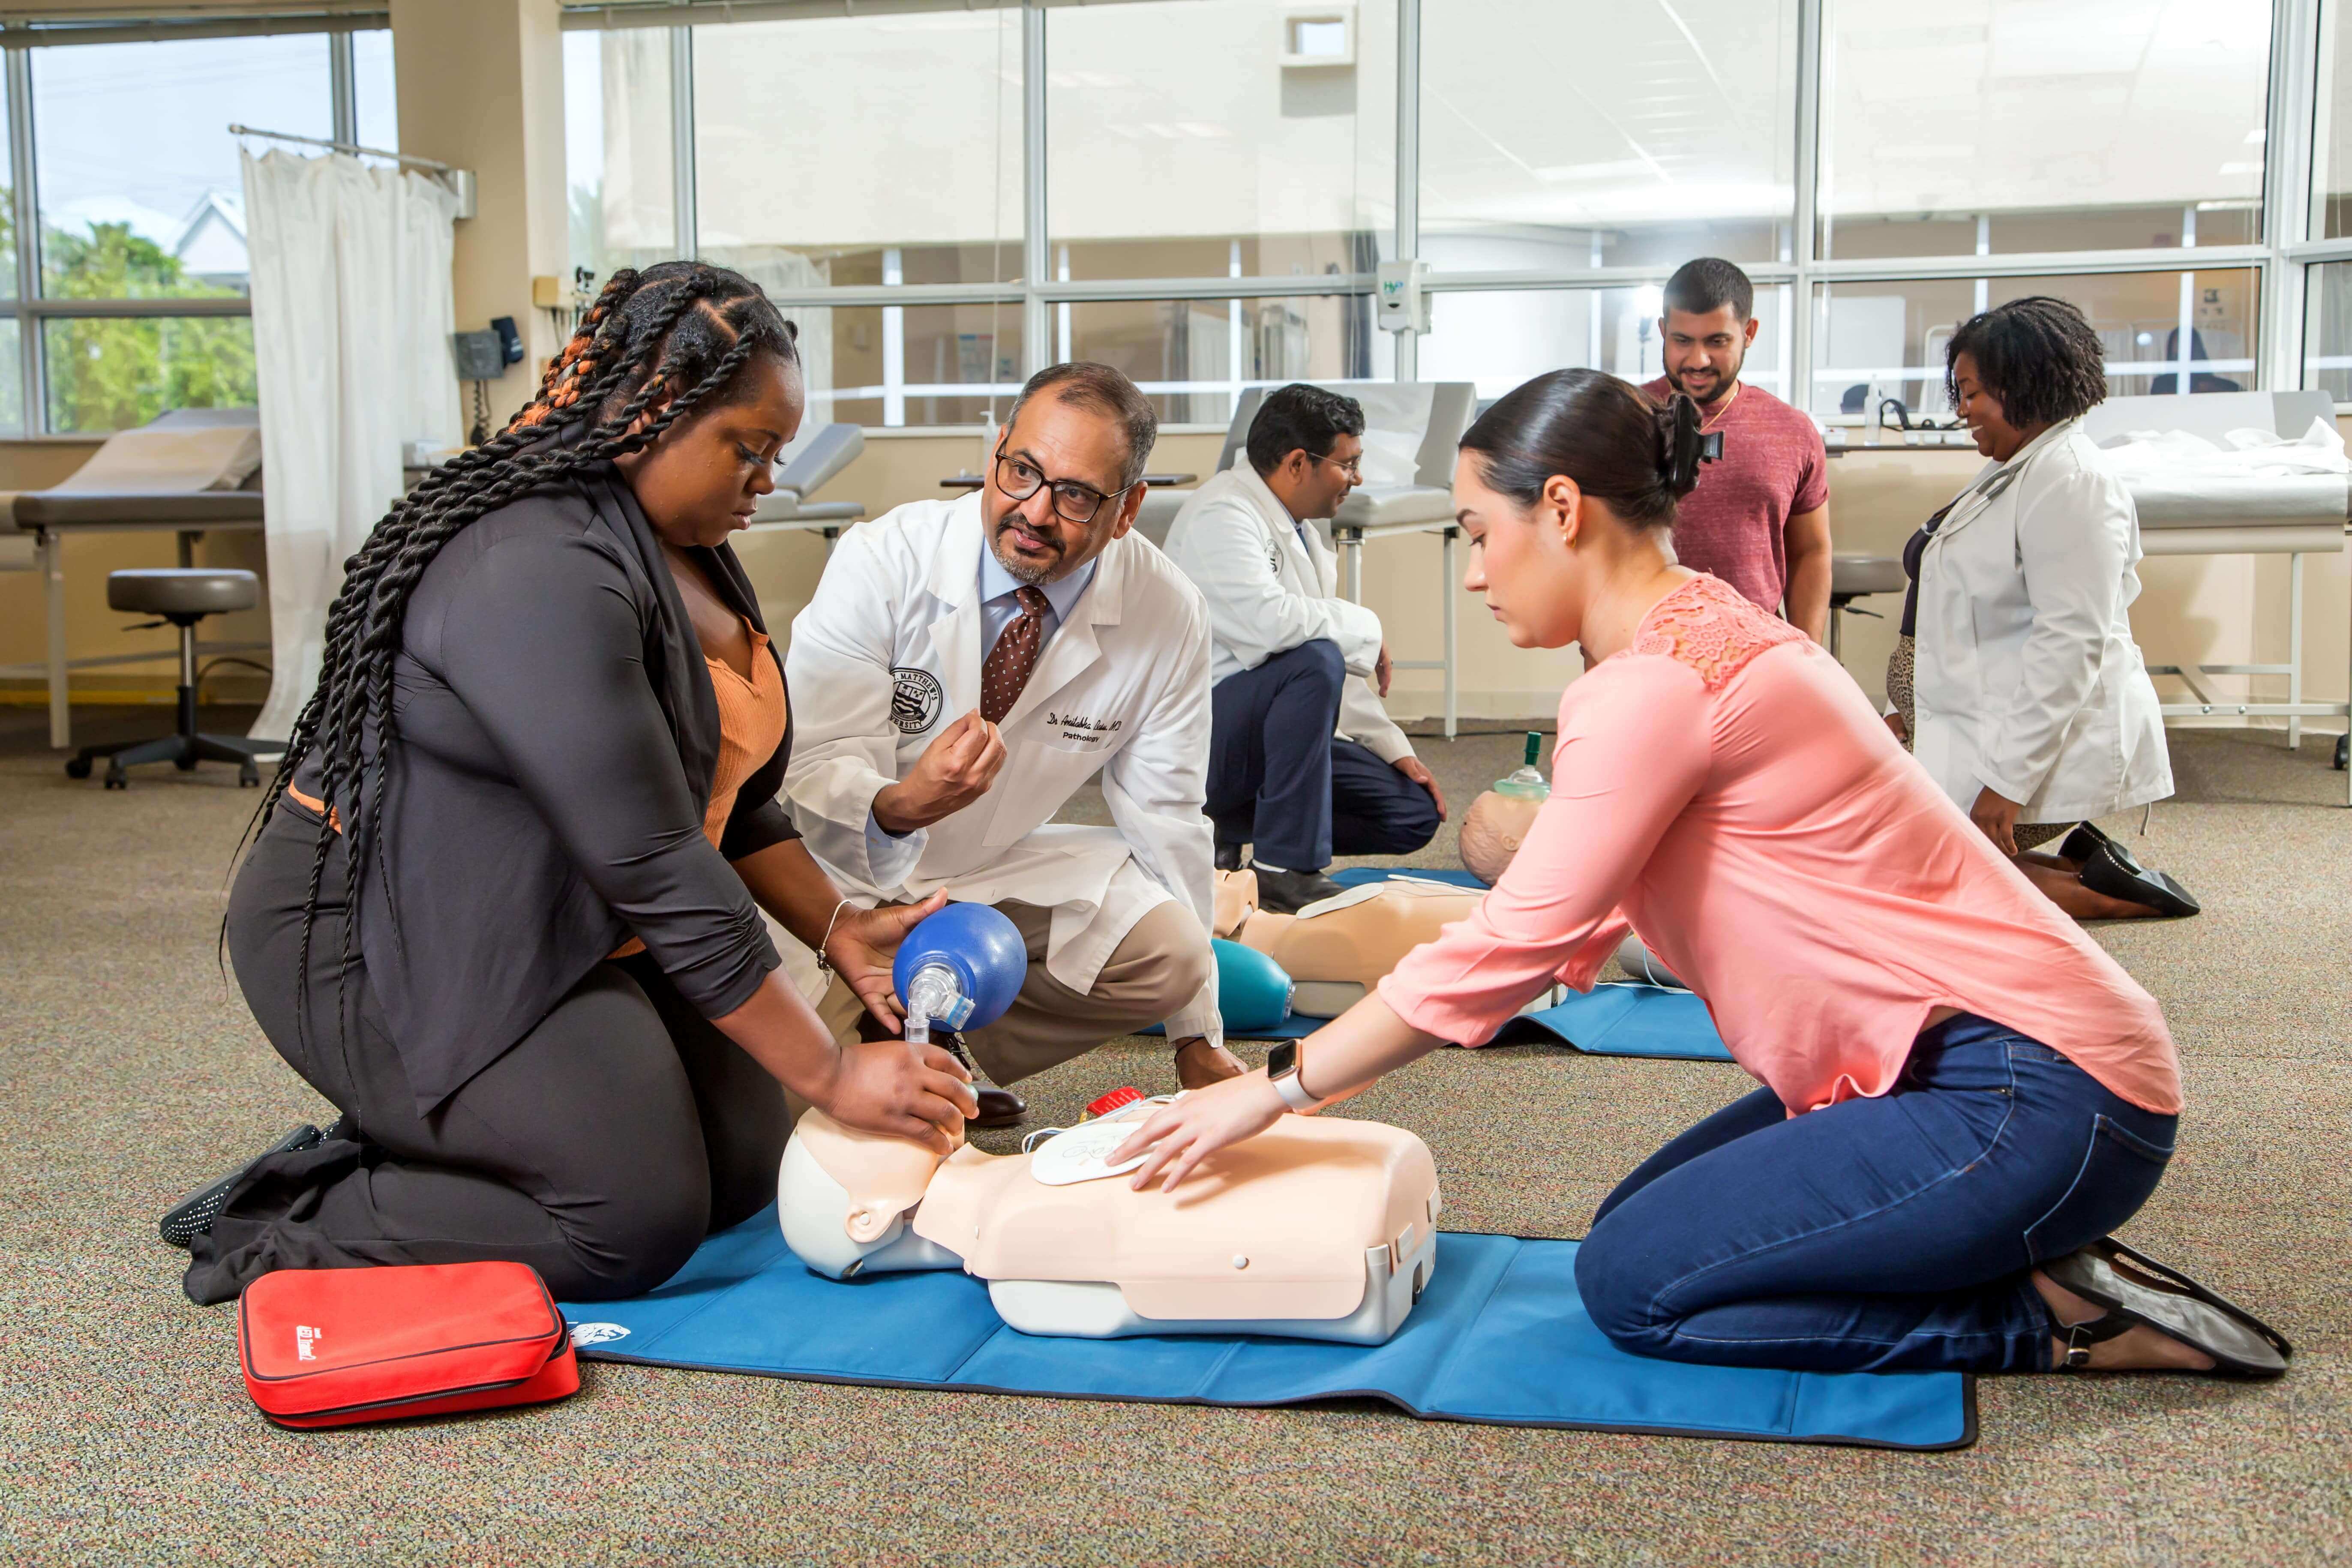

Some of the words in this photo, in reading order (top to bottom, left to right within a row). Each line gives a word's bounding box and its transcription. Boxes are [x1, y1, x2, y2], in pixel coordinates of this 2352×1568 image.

[900, 673, 938, 700] MATTHEW'S
[891, 714, 922, 728] VERSITY
[1063, 732, 1100, 742] Pathology
